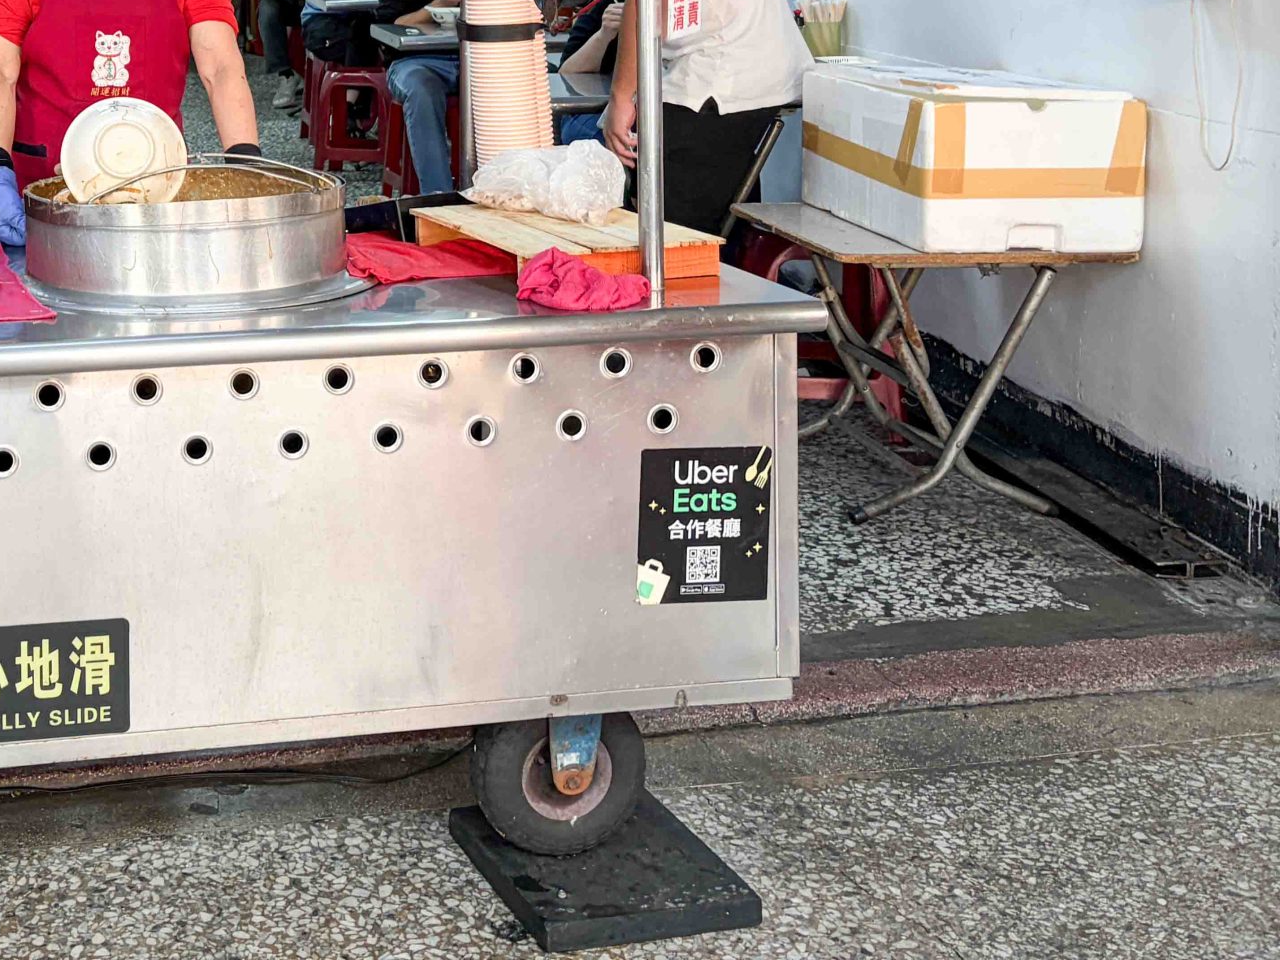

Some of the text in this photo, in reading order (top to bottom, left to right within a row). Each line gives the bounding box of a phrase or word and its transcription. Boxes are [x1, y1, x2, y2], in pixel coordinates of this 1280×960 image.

[674, 460, 738, 485] Uber
[673, 488, 737, 513] Eats
[668, 518, 741, 540] 合作餐廳
[49, 706, 112, 726] SLIDE
